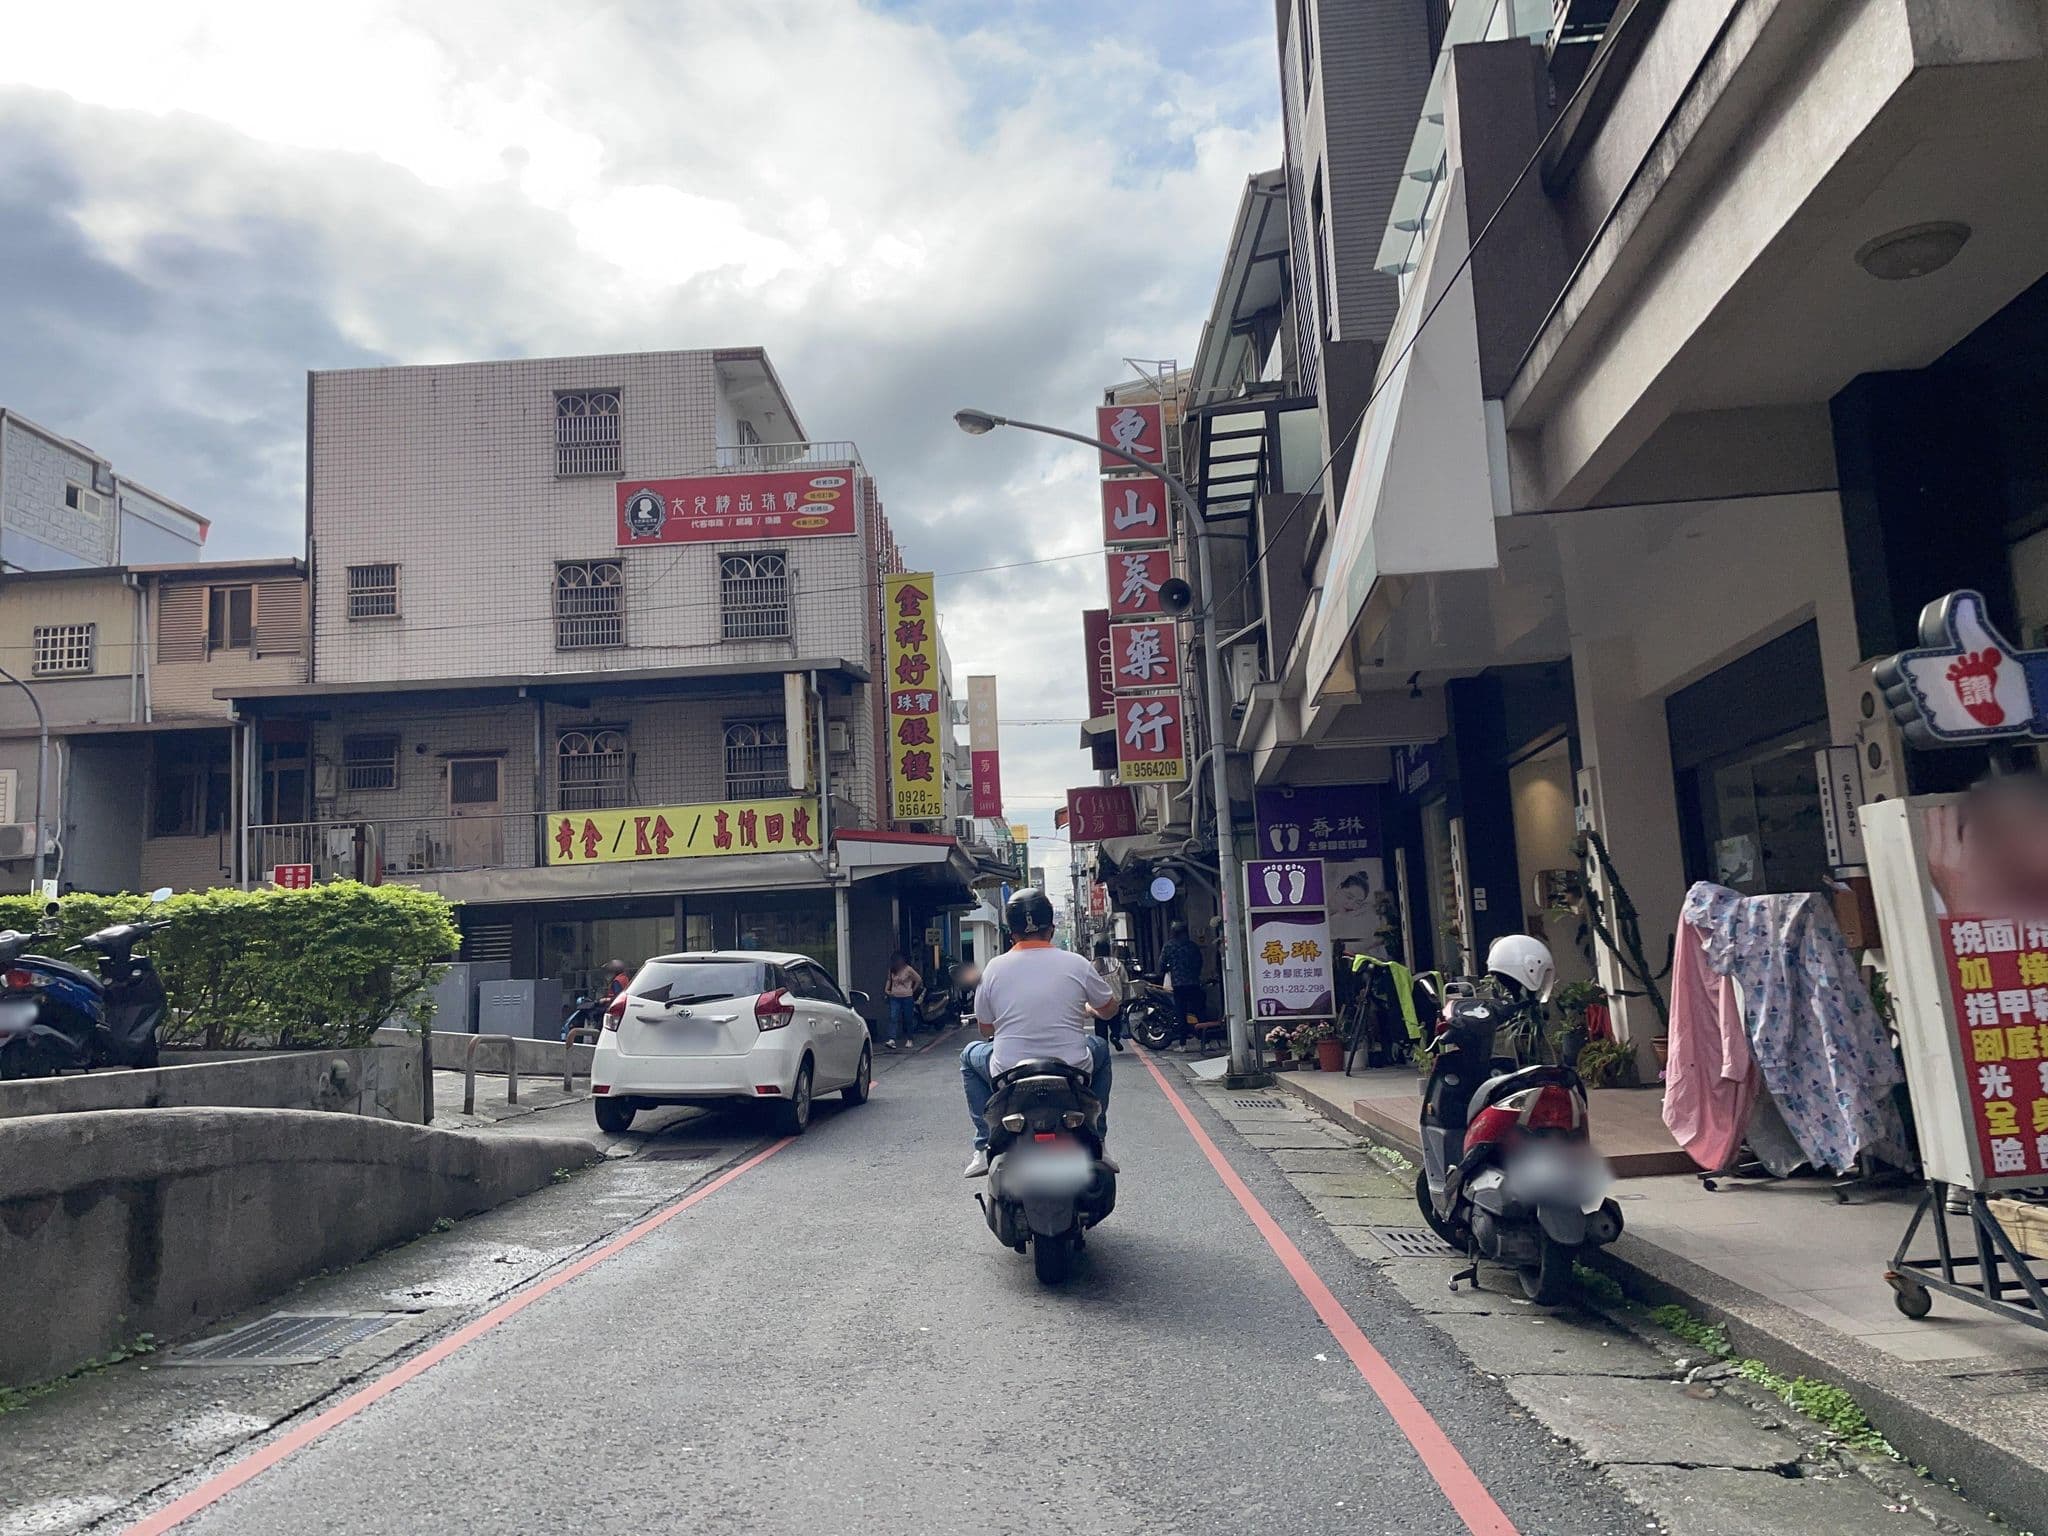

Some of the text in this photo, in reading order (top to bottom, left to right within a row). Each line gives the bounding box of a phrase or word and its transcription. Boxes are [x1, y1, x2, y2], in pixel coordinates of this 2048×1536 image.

[896, 692, 933, 712] 珠寶
[1134, 761, 1177, 778] 9564209
[898, 790, 933, 803] 0928-
[898, 802, 941, 816] 956425
[1262, 984, 1326, 994] 0931-282-298
